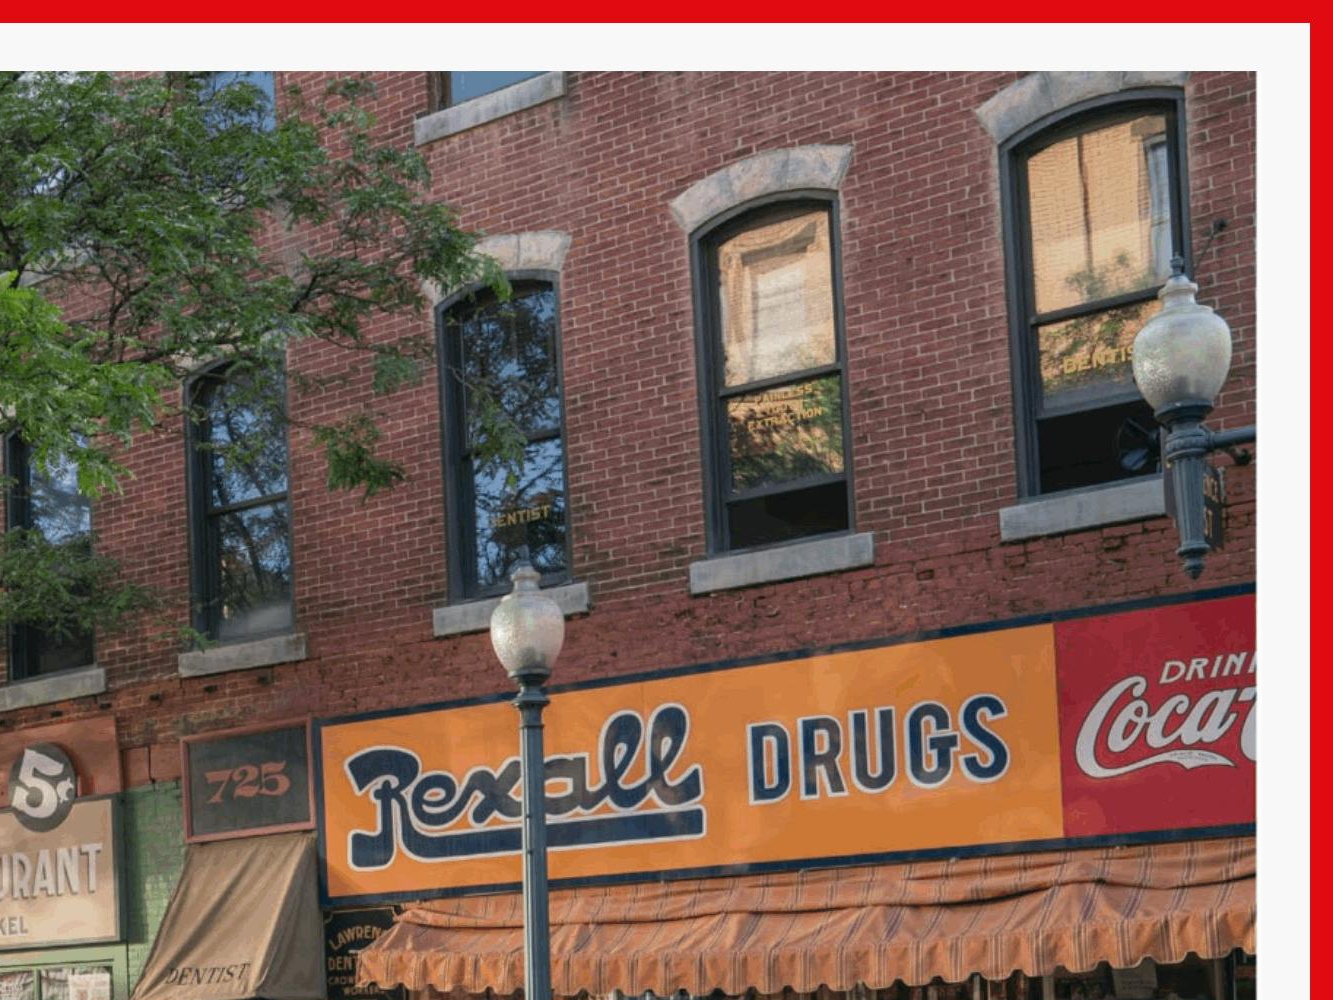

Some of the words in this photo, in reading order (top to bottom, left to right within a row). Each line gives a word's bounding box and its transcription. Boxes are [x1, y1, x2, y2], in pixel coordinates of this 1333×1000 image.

[1159, 652, 1256, 684] DRIN
[11, 748, 75, 818] 5¢
[203, 760, 291, 804] 725
[344, 702, 705, 871] Rexall
[746, 692, 1011, 806] DRUGS
[329, 924, 385, 951] LAWREN
[164, 962, 251, 986] DENTIST
